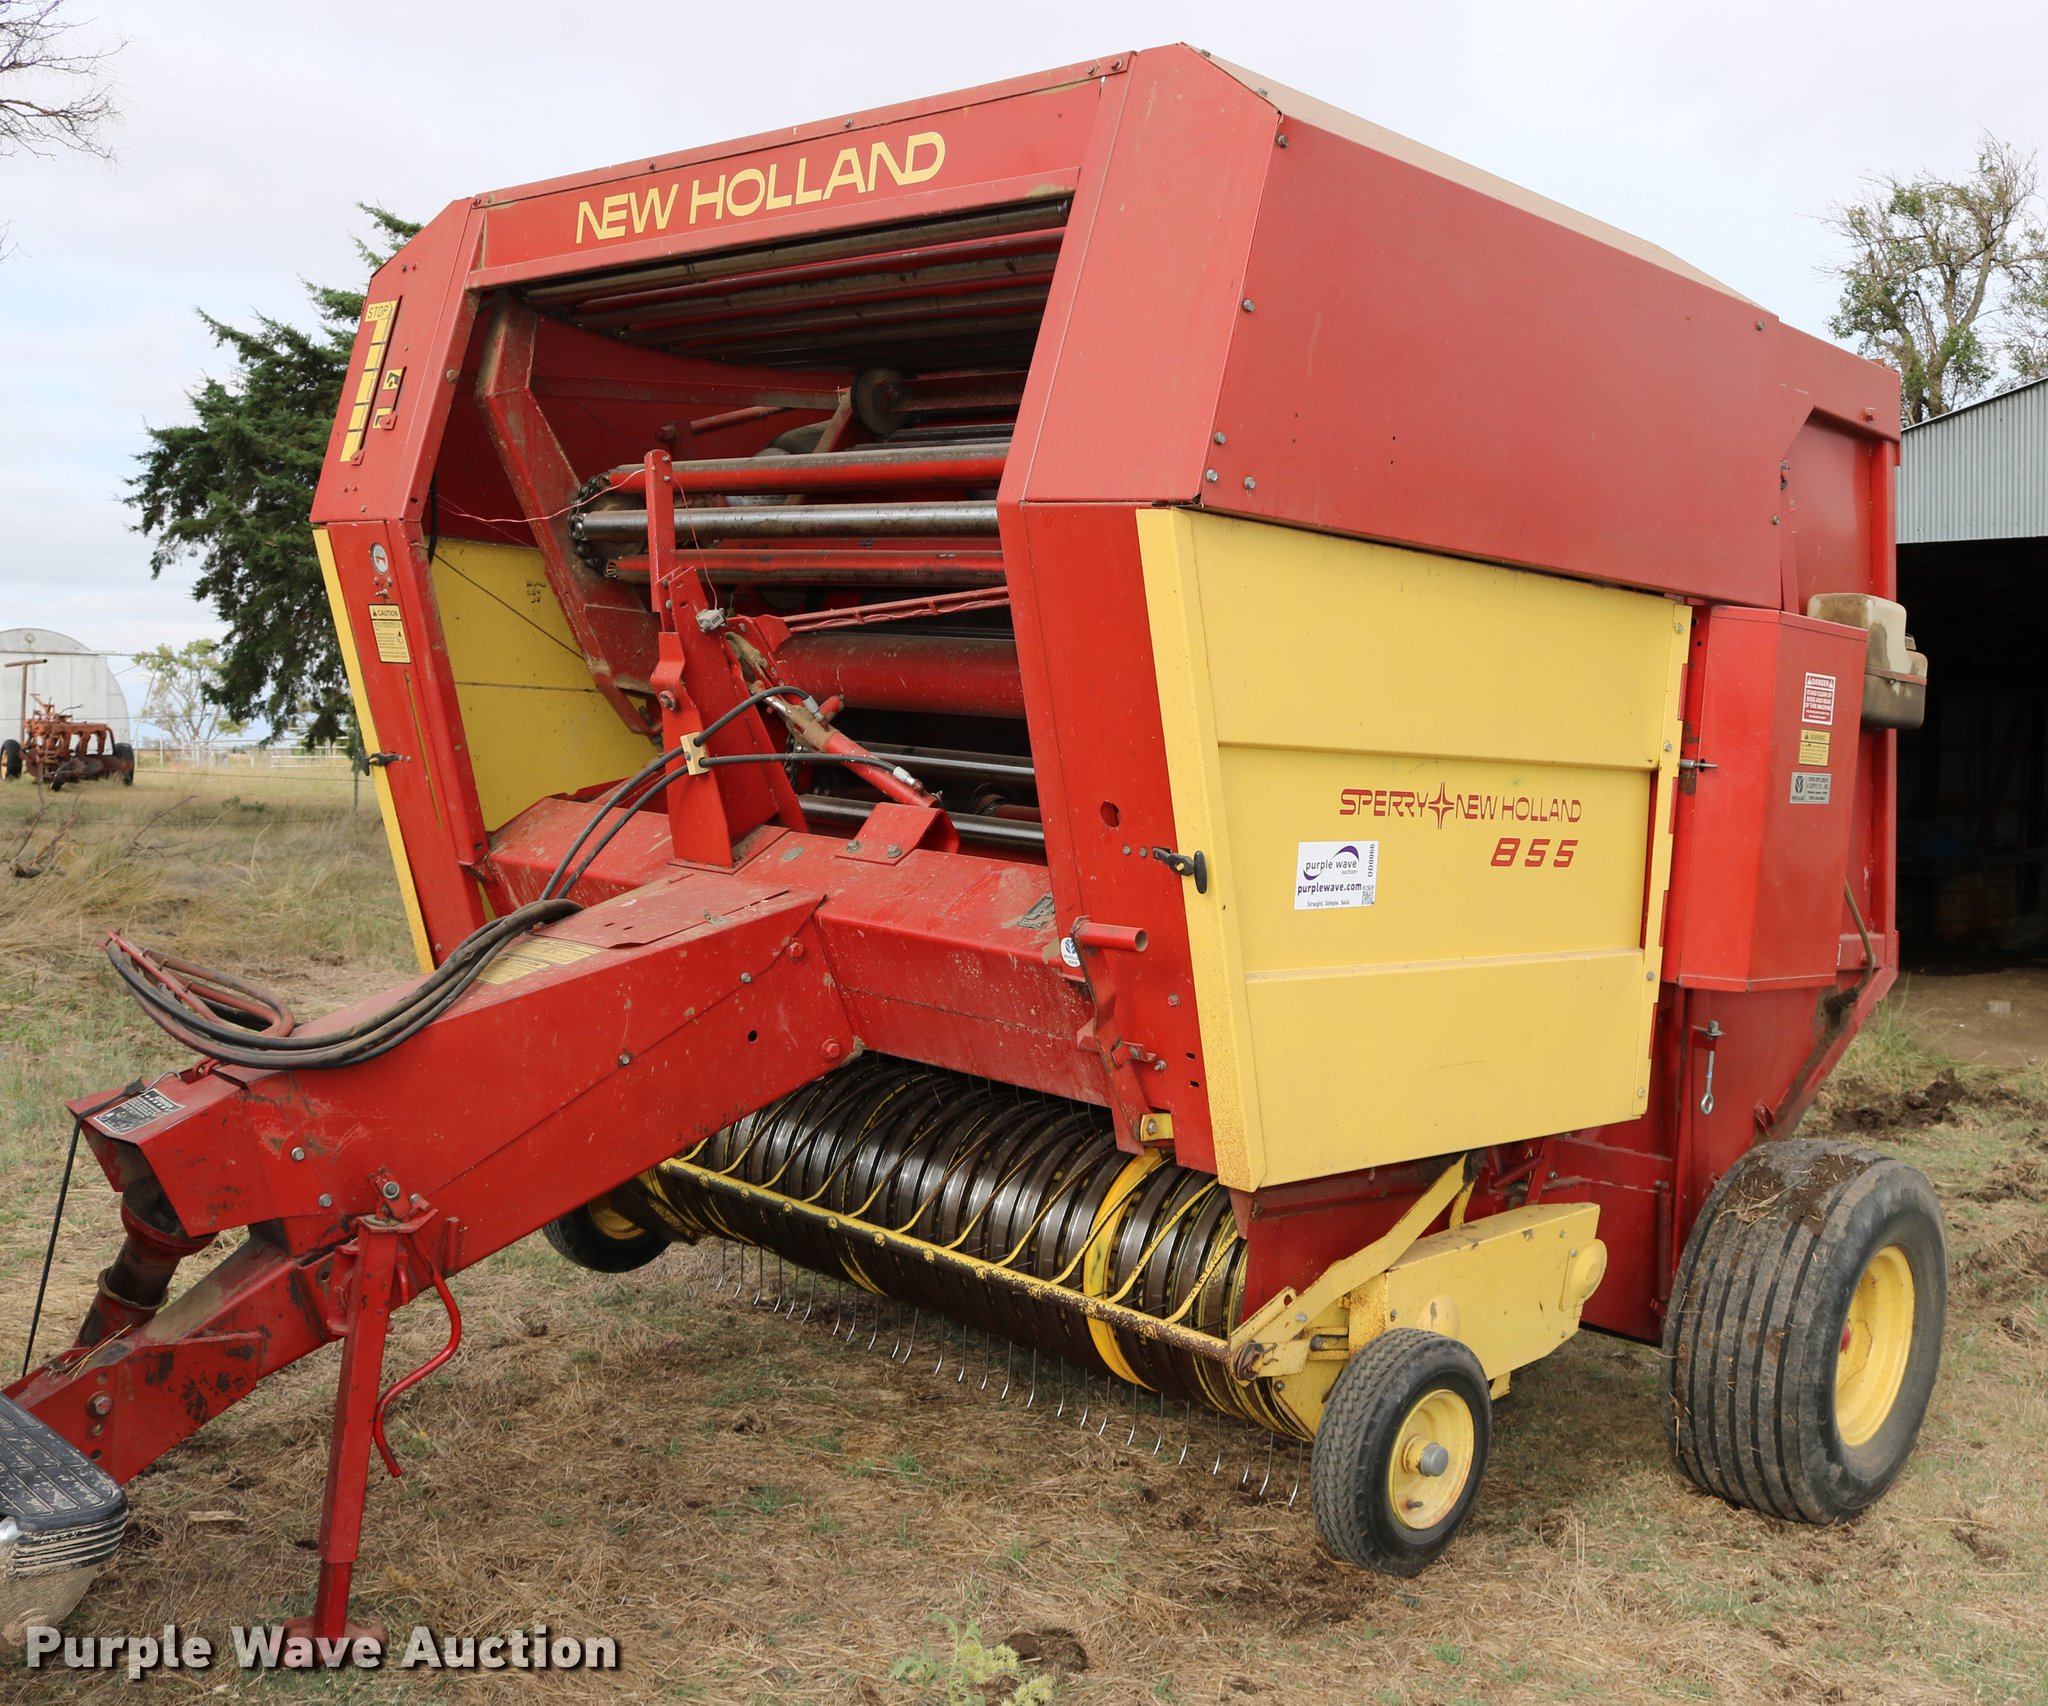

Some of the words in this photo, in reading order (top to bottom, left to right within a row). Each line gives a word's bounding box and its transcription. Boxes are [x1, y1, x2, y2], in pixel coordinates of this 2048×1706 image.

[575, 183, 679, 244] NEW
[689, 131, 946, 224] HOLLAND
[367, 304, 389, 319] STOP
[377, 609, 399, 617] CAUTION
[1339, 788, 1429, 818] SPERRY
[1455, 794, 1498, 820] NEW
[1501, 796, 1583, 823] HOLLAND
[1367, 844, 1376, 877] DD0066
[1490, 837, 1579, 868] 855
[1305, 860, 1333, 871] purple
[1336, 860, 1357, 869] wave
[1297, 882, 1362, 896] purplewave.com
